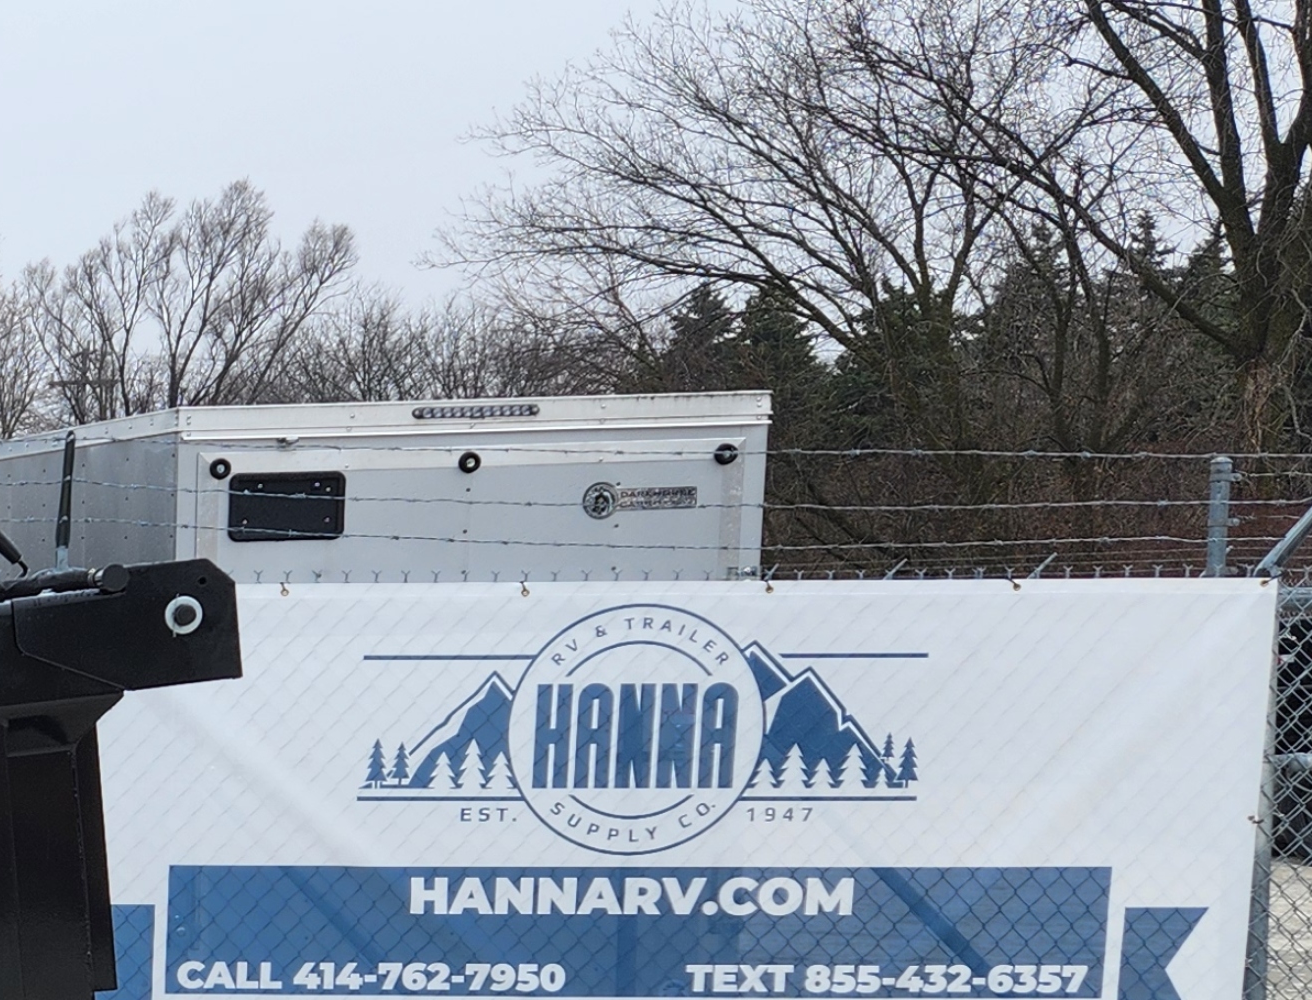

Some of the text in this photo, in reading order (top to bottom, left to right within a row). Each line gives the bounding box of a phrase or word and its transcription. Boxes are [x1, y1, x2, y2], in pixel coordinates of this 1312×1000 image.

[550, 616, 730, 666] RV & TRAILER
[531, 682, 739, 789] HANNA
[459, 807, 518, 822] EST.
[549, 801, 717, 843] SUPPLY CO.
[746, 806, 814, 823] 1947
[408, 876, 855, 916] HANNARV.COM
[176, 960, 567, 993] CALL 414-762-7950
[685, 964, 1088, 994] TEXT 855-432-6357
